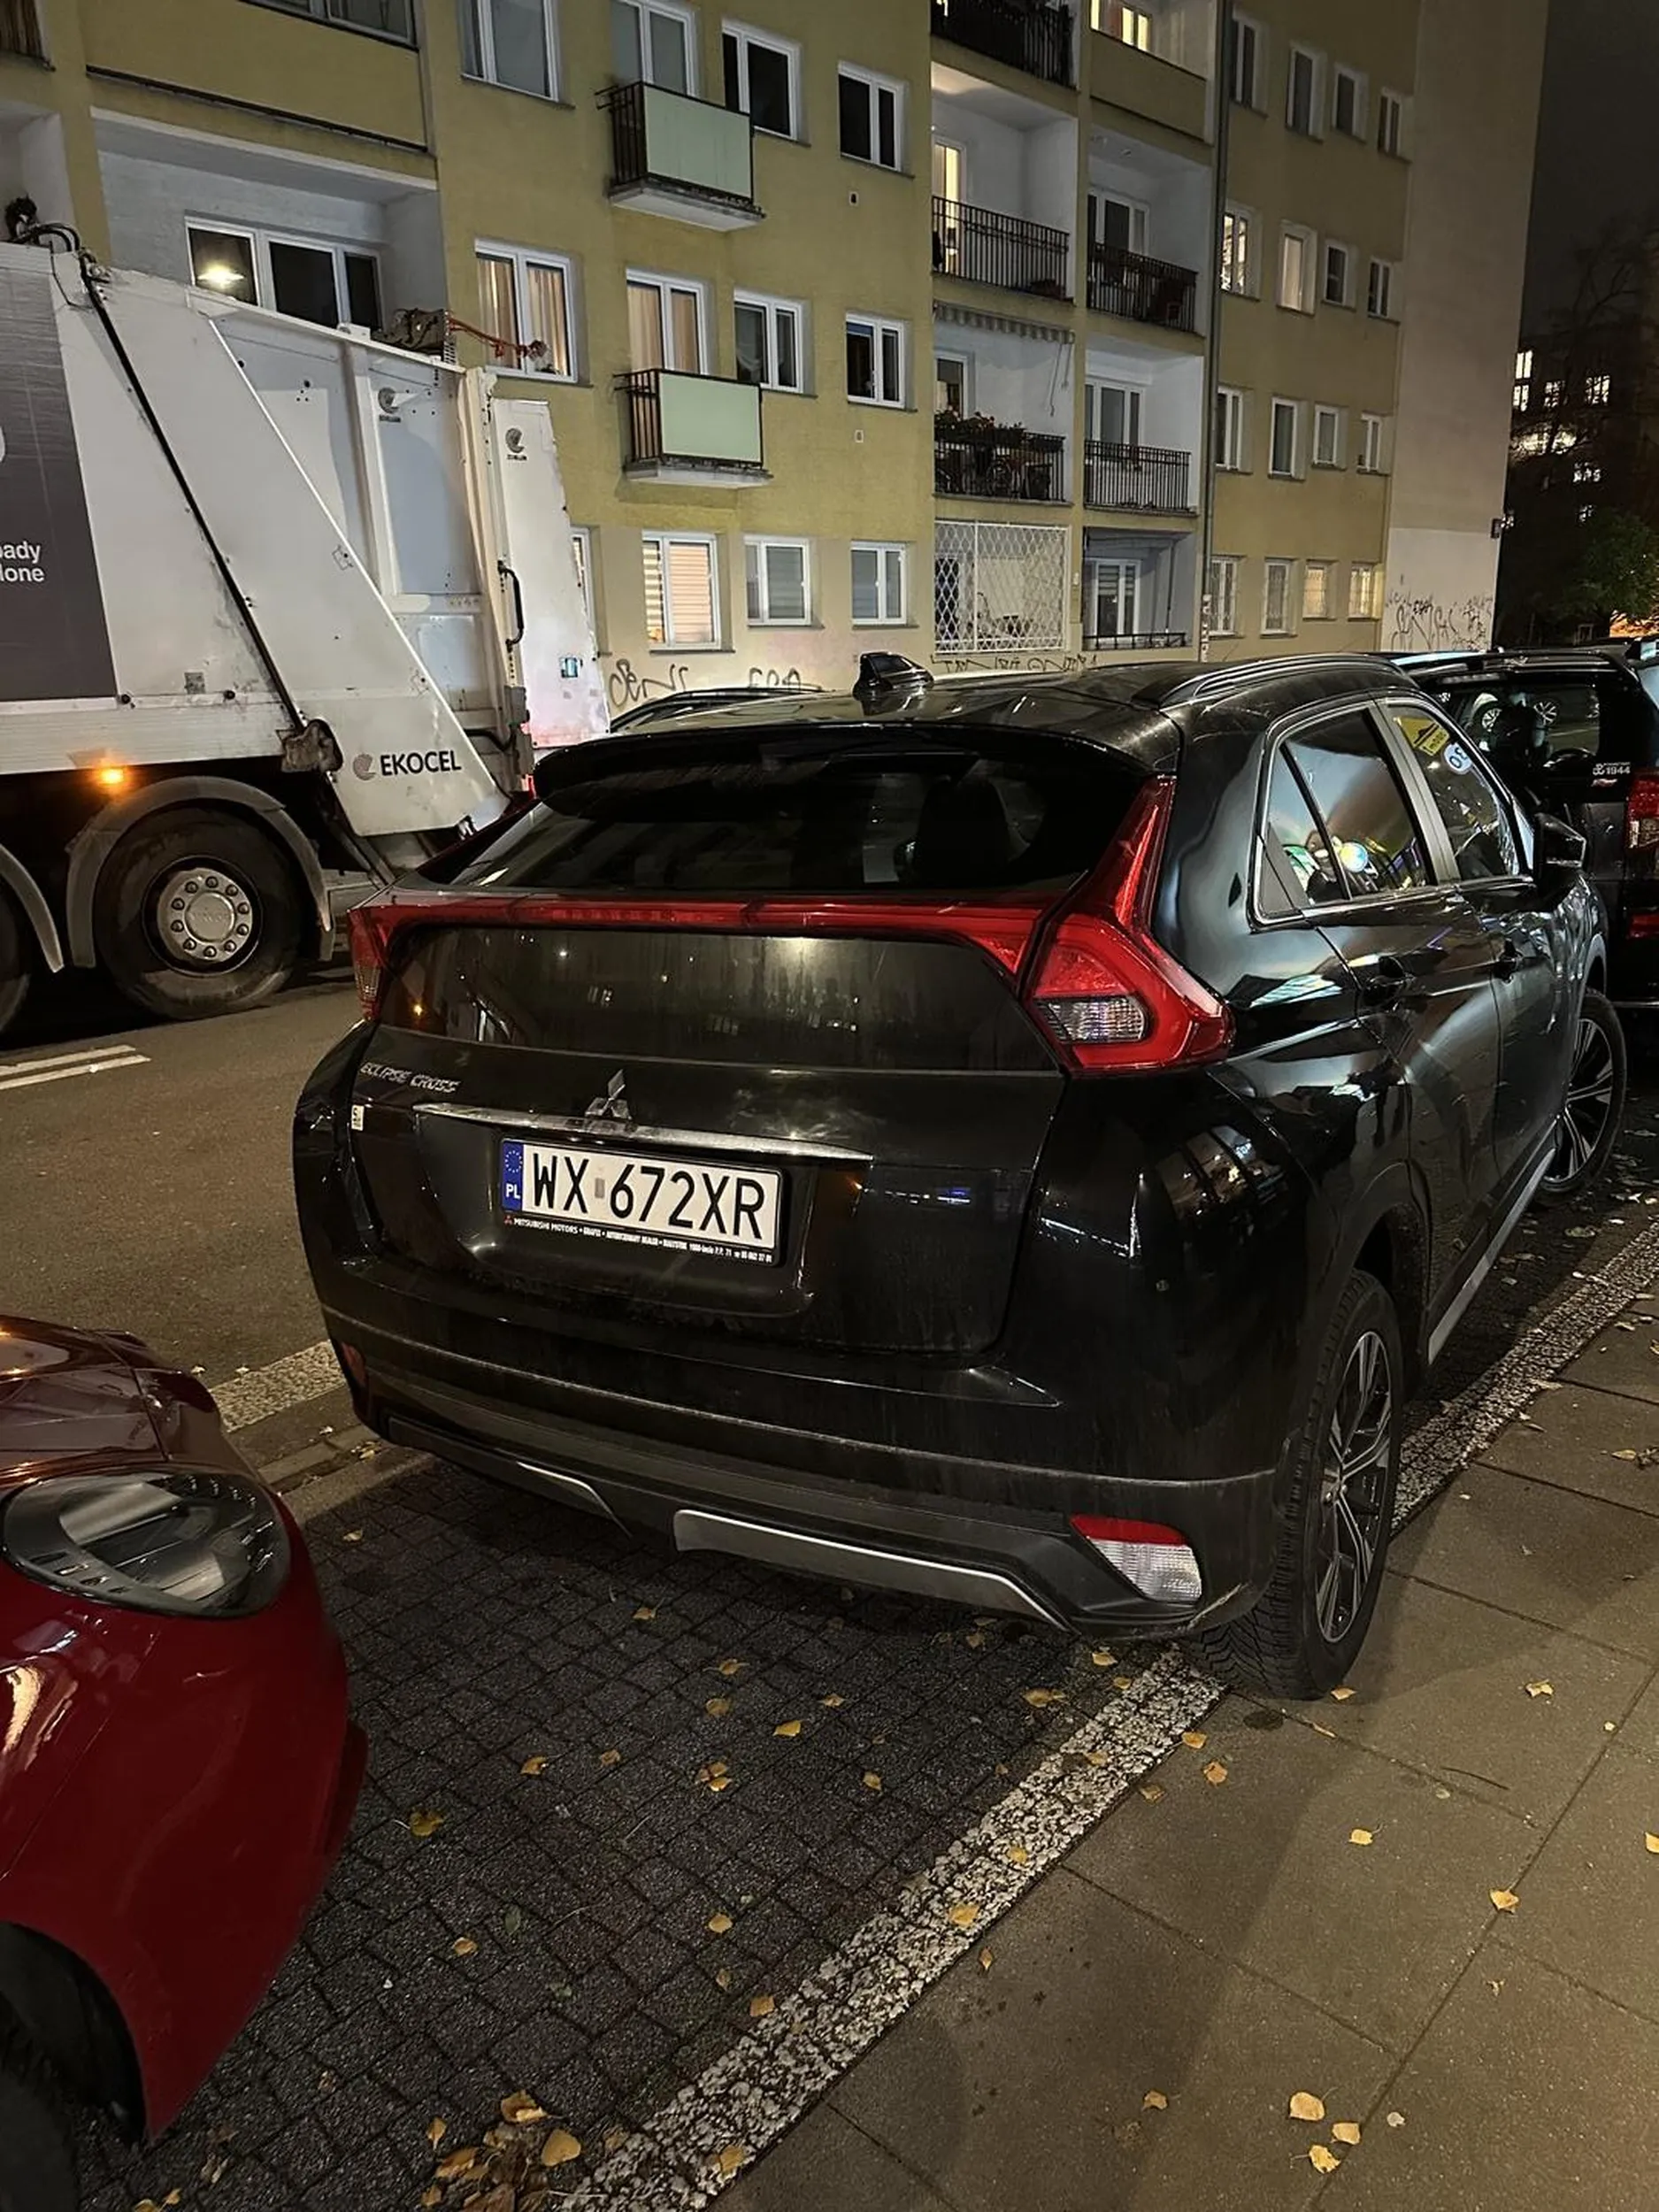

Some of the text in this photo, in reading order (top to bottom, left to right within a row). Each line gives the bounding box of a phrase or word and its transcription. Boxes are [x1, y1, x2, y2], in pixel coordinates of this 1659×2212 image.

[380, 750, 462, 776] EKOCEL
[1605, 766, 1630, 775] 1944
[360, 1062, 461, 1094] ECLIPSE CROSS
[506, 1183, 520, 1199] PL
[533, 1152, 764, 1240] WX 672XR
